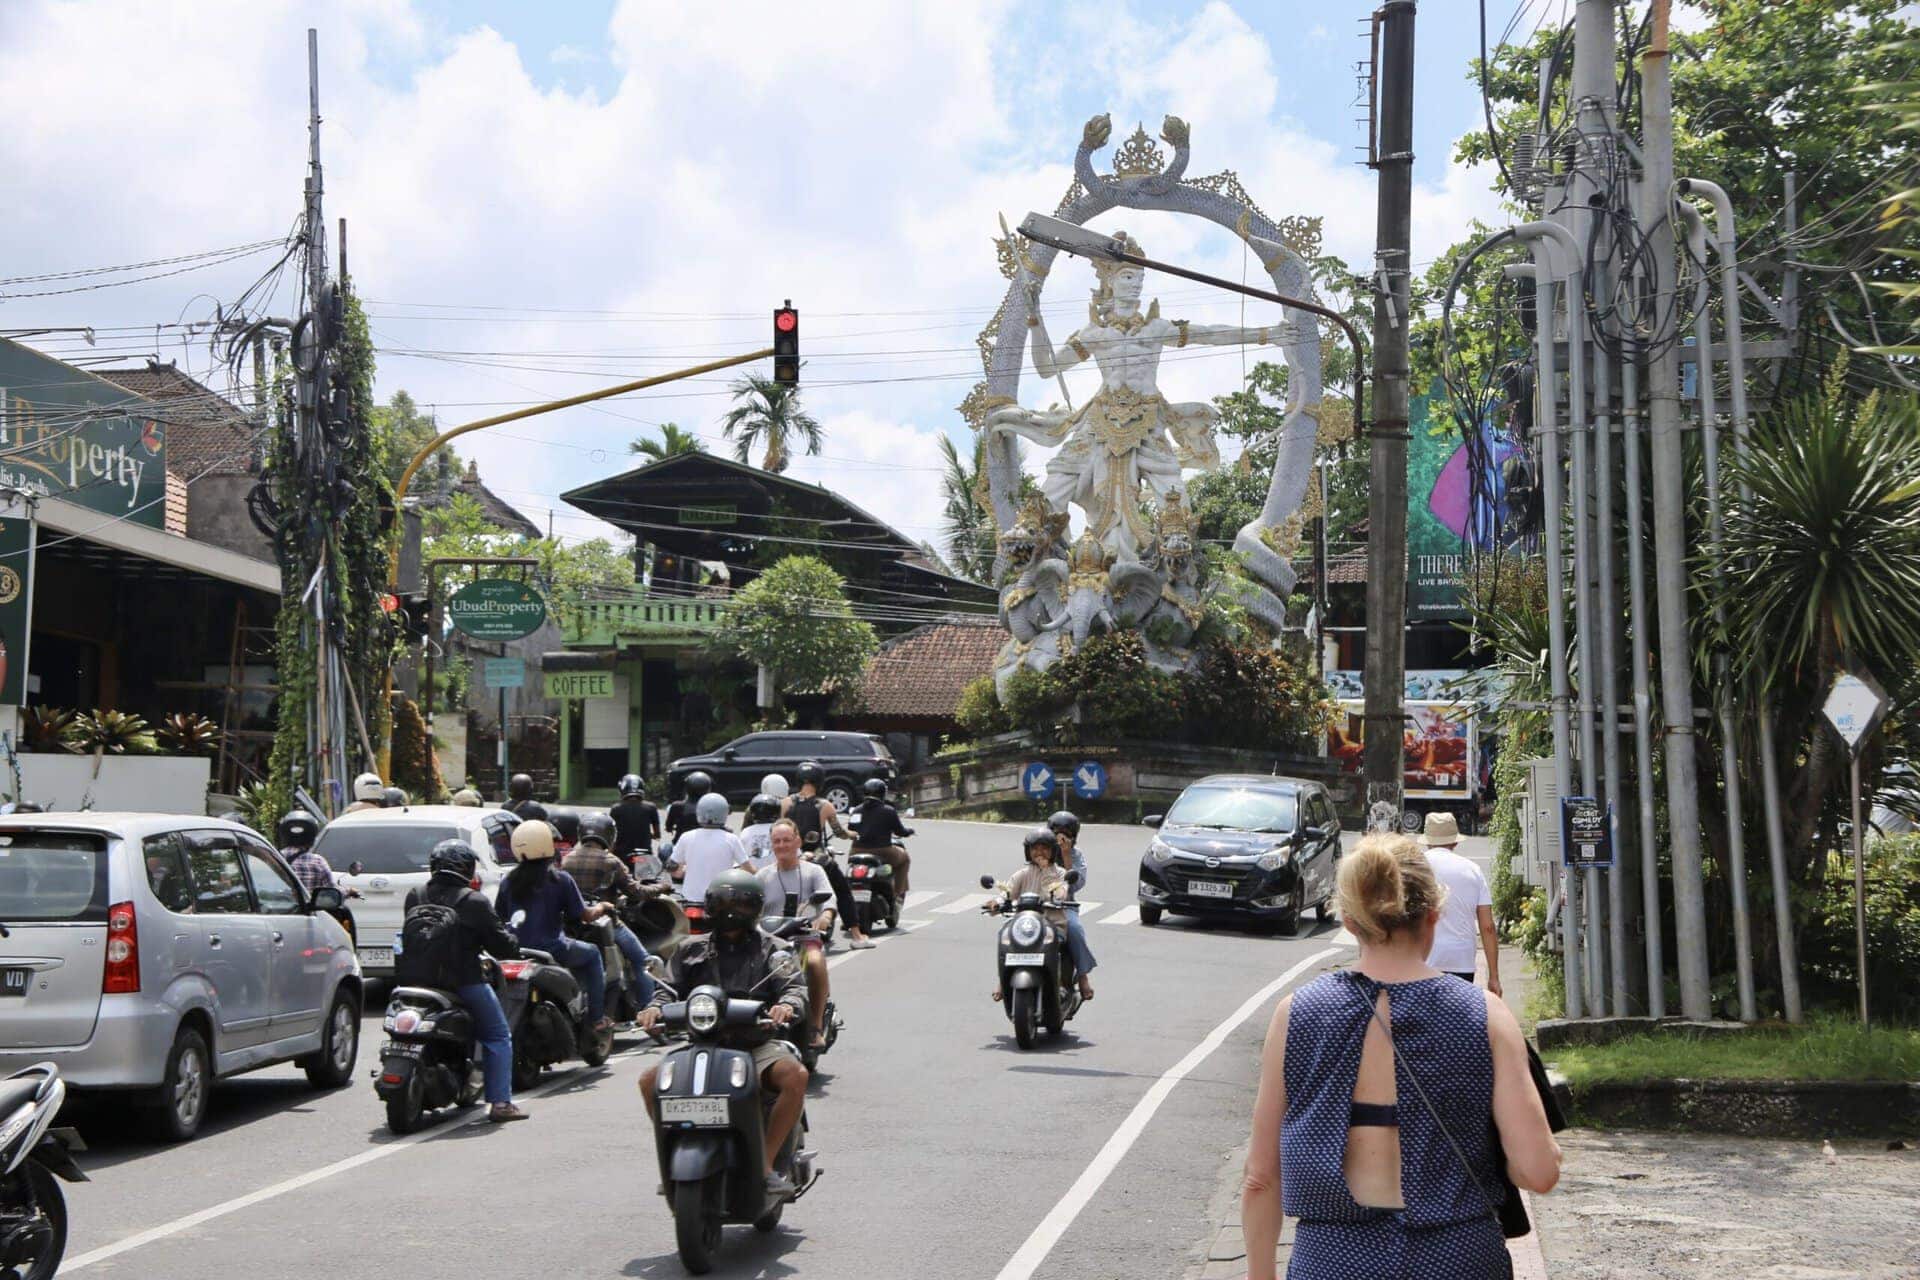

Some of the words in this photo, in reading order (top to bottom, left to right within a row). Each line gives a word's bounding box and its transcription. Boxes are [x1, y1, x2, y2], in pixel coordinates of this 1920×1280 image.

[452, 600, 543, 615] UbudProperty
[552, 675, 609, 696] COFFEE
[7, 971, 23, 987] VD
